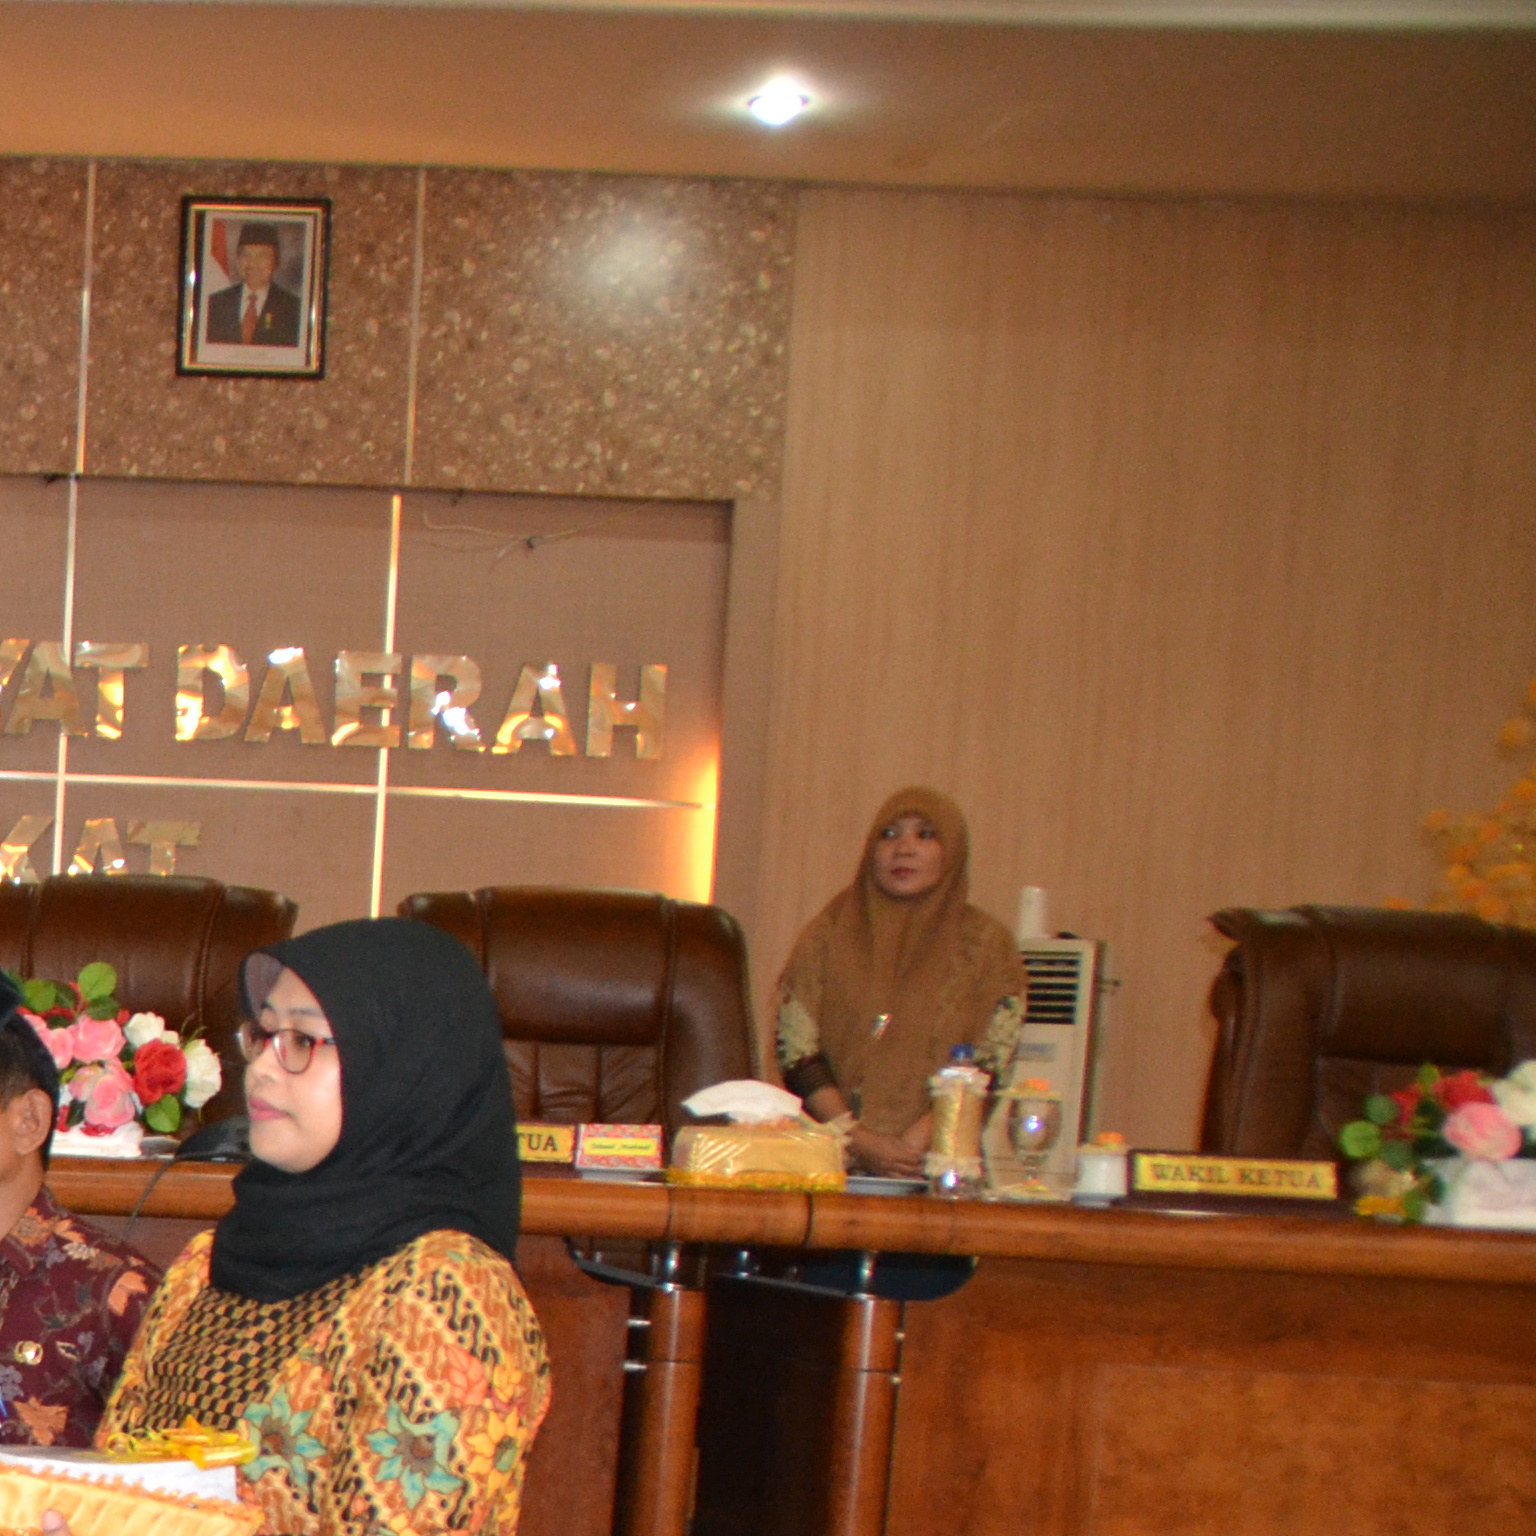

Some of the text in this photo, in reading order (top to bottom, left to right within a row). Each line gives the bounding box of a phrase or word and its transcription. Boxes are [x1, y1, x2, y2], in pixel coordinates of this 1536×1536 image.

[174, 643, 668, 760] DAERAH
[1152, 1163, 1322, 1189] WAKIL KETUA
